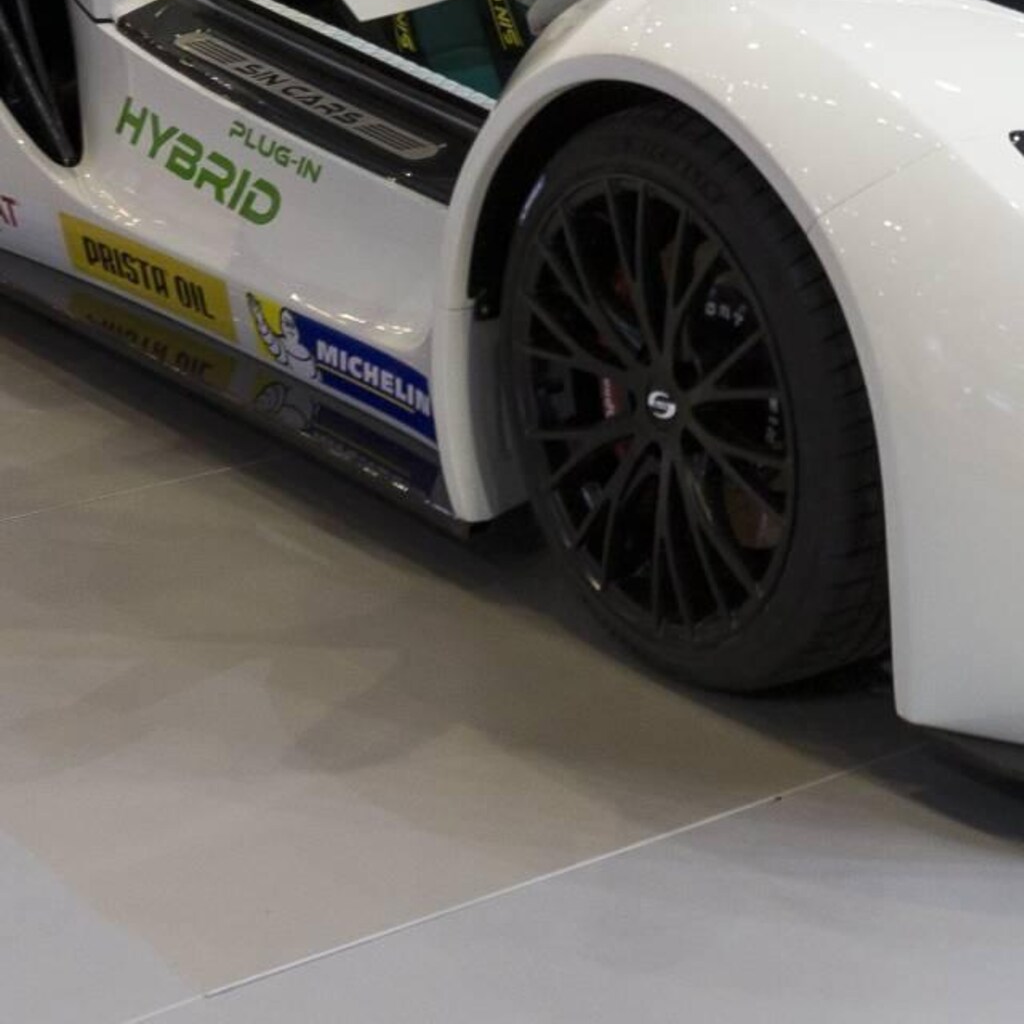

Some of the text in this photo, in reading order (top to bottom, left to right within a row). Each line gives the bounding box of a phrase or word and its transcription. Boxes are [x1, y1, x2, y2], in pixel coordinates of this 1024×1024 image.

[234, 63, 364, 126] SIN CARS
[115, 96, 281, 226] HYBRID
[228, 121, 322, 184] PLUG-IN
[82, 235, 215, 320] PRISTA OIL
[317, 339, 431, 417] MICHELIN
